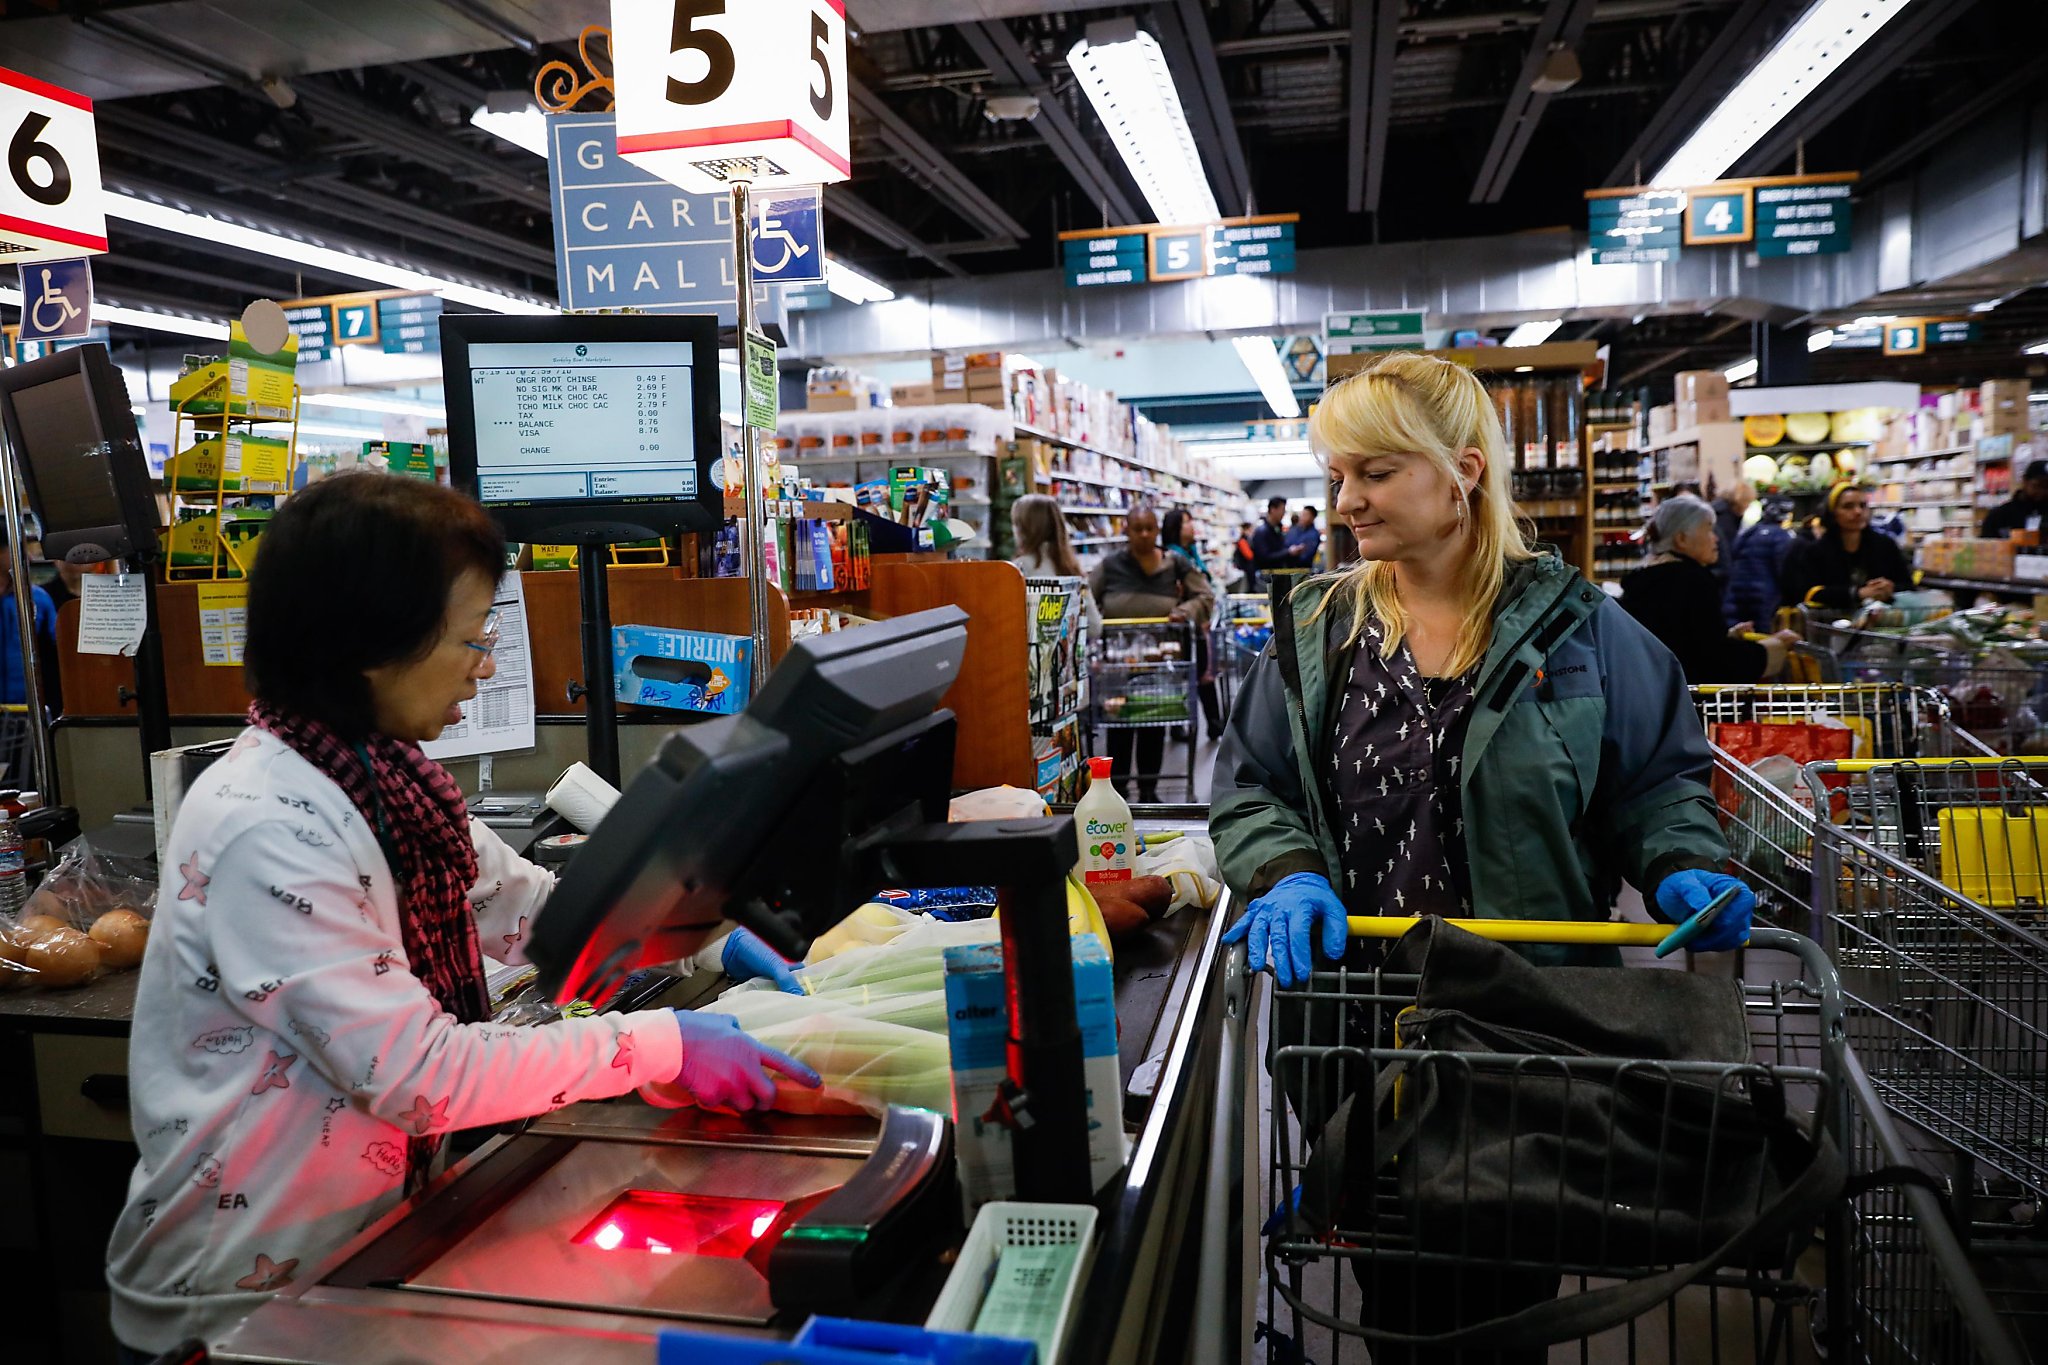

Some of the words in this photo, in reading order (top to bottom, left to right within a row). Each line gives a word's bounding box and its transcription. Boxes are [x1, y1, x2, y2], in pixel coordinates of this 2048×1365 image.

[665, 0, 736, 106] 5
[809, 9, 833, 122] 5
[8, 110, 72, 206] 6
[1705, 201, 1733, 232] 4
[1168, 241, 1190, 269] 5
[345, 309, 364, 336] 7
[23, 341, 40, 362] 8
[474, 377, 485, 385] WT
[515, 376, 536, 384] GNGR
[566, 375, 597, 383] CHINSE
[516, 385, 527, 393] NO
[531, 385, 547, 393] SIG
[551, 384, 563, 392] MK
[567, 384, 578, 392] CH
[582, 384, 598, 392] BAR
[203, 391, 220, 399] MATE
[516, 394, 538, 402] TCHO
[542, 393, 563, 401] MILK
[567, 393, 588, 401] CHOC
[637, 392, 658, 400] 2.79
[518, 402, 538, 410] TCHO
[543, 402, 563, 410] MILK
[593, 401, 609, 409] CAC
[518, 420, 554, 428] BALANCE
[638, 418, 659, 426] 8.76
[519, 429, 540, 437] VISA
[638, 427, 659, 435] 8.76
[194, 462, 216, 470] YERBA
[197, 469, 213, 477] MATE
[541, 545, 560, 553] MATE
[664, 633, 736, 664] NITRILE
[1086, 822, 1128, 835] ecover
[376, 1146, 400, 1171] Hello
